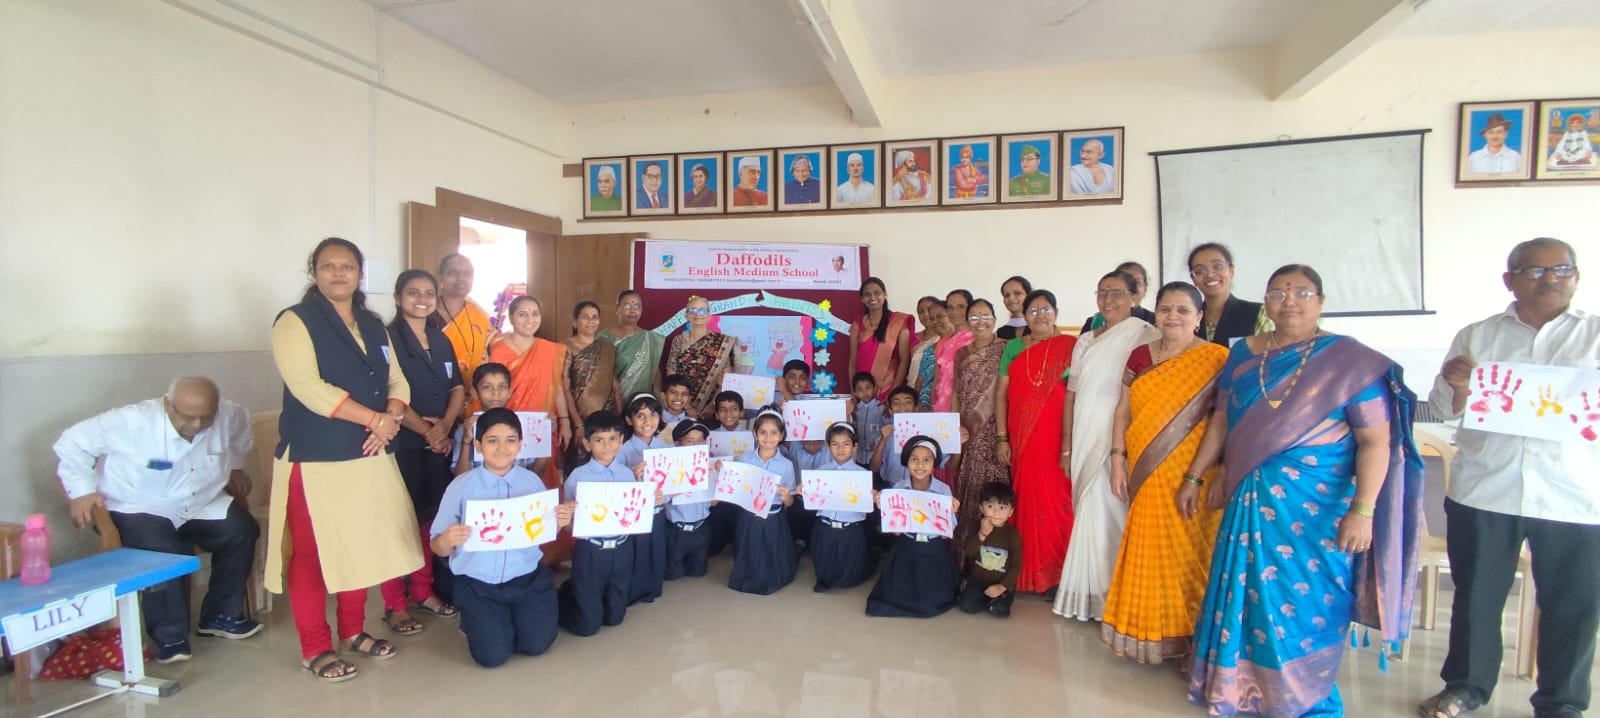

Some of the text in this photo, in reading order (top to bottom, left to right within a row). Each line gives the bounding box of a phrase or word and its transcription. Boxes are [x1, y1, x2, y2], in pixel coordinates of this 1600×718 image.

[716, 253, 792, 266] Daffodils
[688, 267, 819, 277] English Medium School
[710, 298, 746, 312] GRAND
[32, 596, 89, 632] LILY
